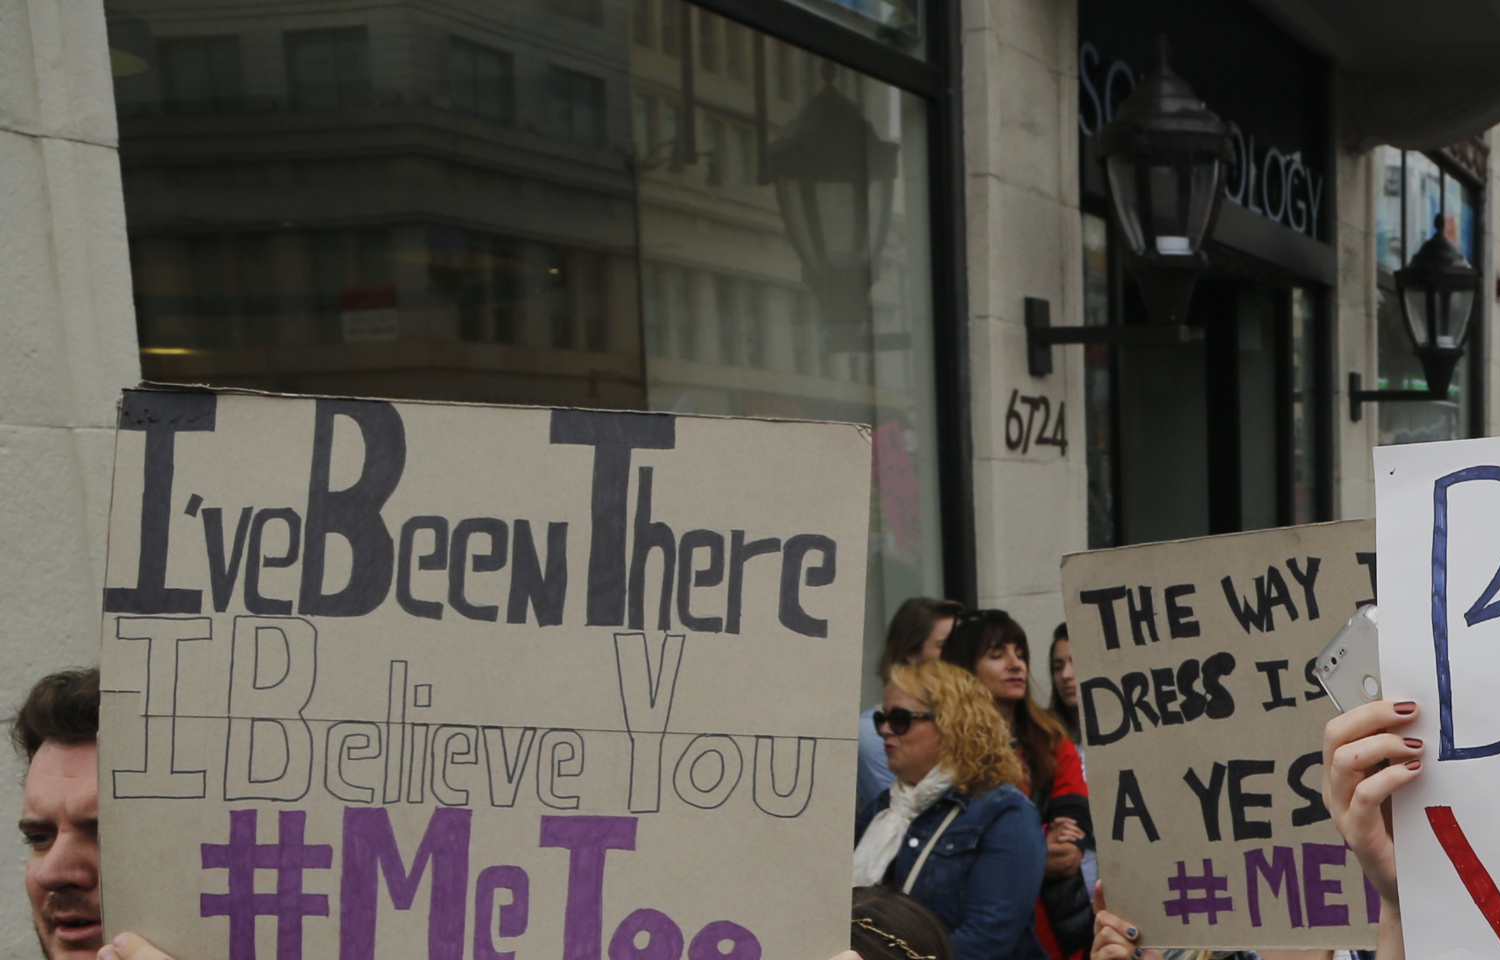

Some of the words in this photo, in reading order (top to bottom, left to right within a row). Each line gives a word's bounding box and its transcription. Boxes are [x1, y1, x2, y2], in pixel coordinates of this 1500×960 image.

[1005, 389, 1068, 457] 6724
[104, 390, 304, 615] I've
[550, 408, 837, 638] There
[1080, 583, 1200, 650] THE
[1221, 556, 1321, 634] WAY
[113, 617, 211, 799] I
[224, 616, 584, 810] Believe
[614, 632, 816, 818] You
[1080, 652, 1236, 746] DRESS
[1255, 656, 1328, 712] IS
[1111, 769, 1161, 842] A
[1182, 750, 1332, 842] YES
